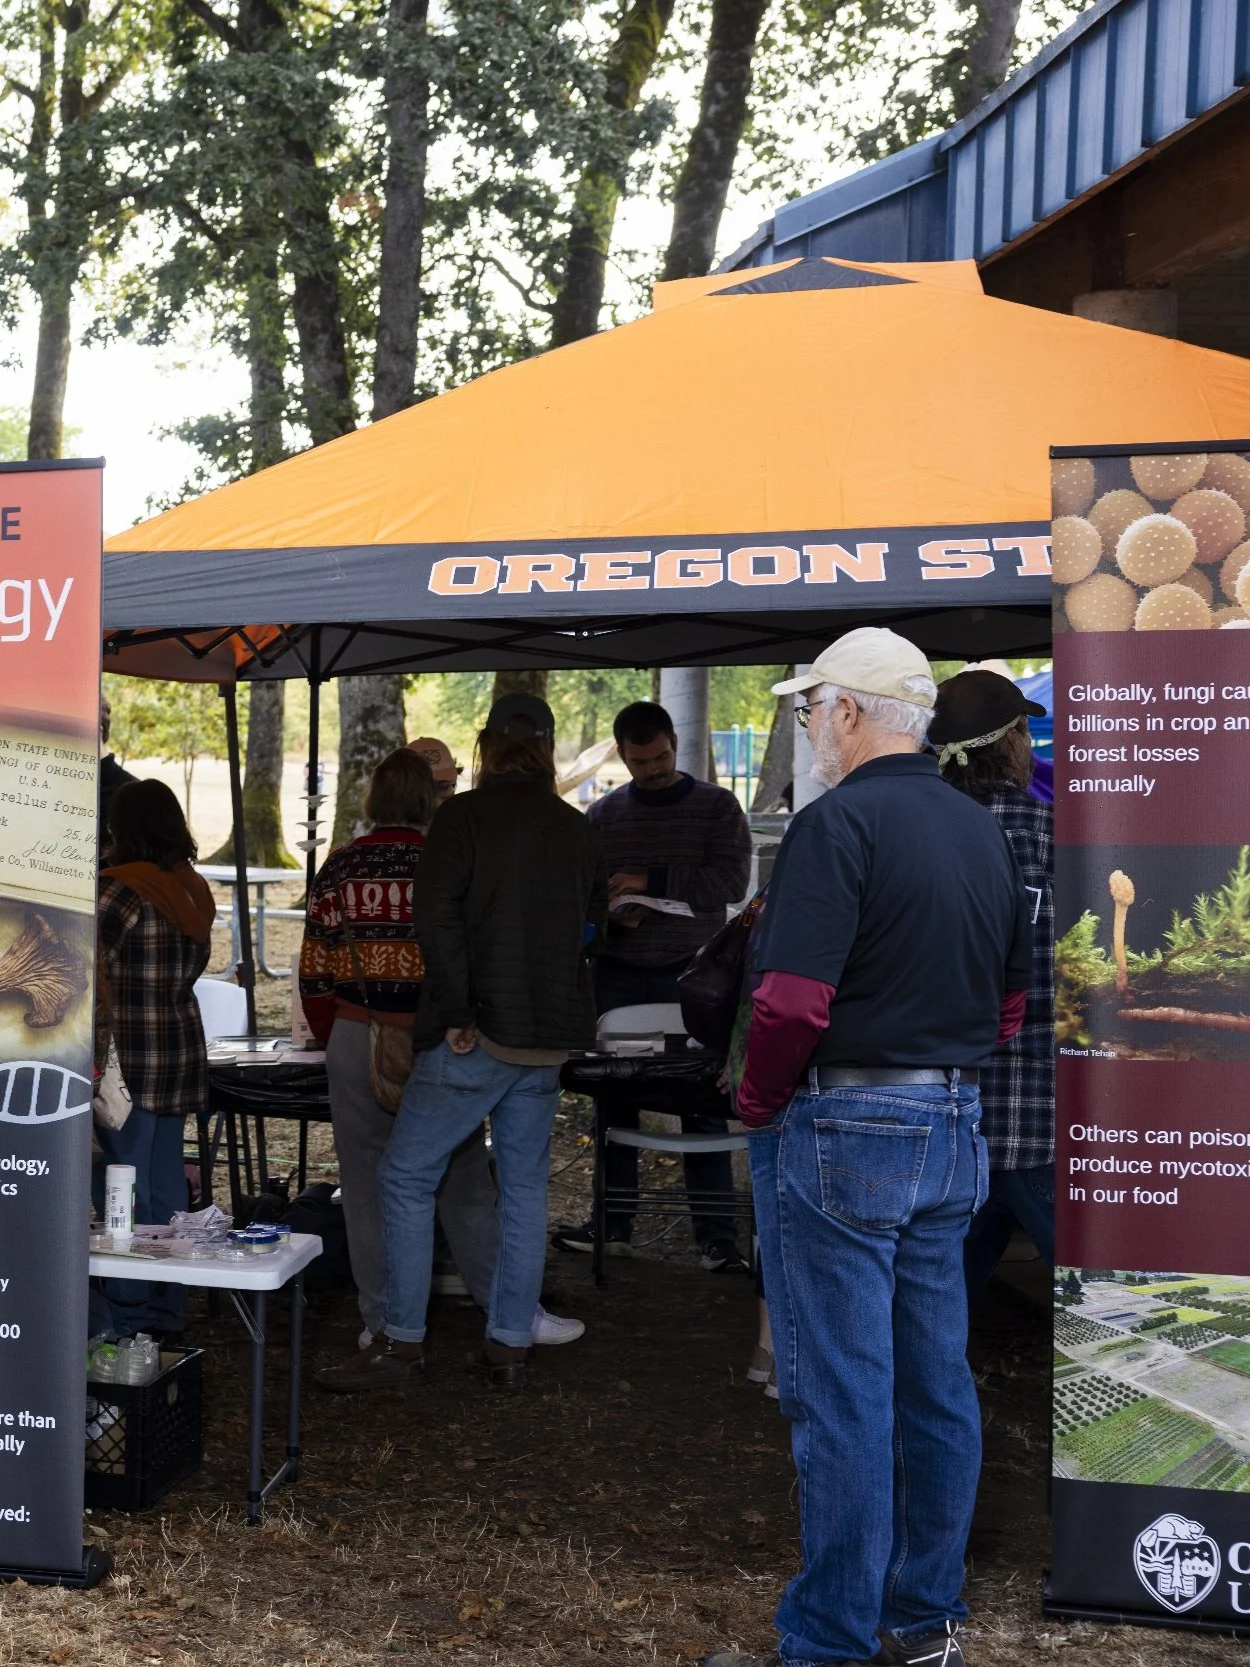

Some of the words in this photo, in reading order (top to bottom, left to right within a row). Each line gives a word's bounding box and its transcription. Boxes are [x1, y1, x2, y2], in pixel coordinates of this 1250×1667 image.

[428, 542, 889, 596] OREGON
[917, 535, 1052, 580] ST
[1068, 683, 1157, 705] Globally,
[1163, 682, 1215, 705] fungi
[1221, 685, 1250, 700] ca
[1068, 714, 1140, 732] billions
[1146, 713, 1164, 731] in
[1170, 716, 1217, 735] crop
[1223, 716, 1250, 731] an
[15, 742, 50, 756] STATE
[1068, 744, 1128, 762] forest
[1133, 744, 1201, 762] losses
[25, 761, 41, 771] OF
[45, 764, 95, 782] OREGON
[1068, 774, 1156, 797] annually
[29, 858, 85, 879] Willamette
[1060, 1047, 1089, 1057] Richard
[1091, 1049, 1116, 1058] Tehan
[1069, 1124, 1139, 1144] Others
[1144, 1129, 1182, 1145] can
[1069, 1155, 1152, 1175] produce
[1069, 1183, 1086, 1201] in
[1092, 1188, 1127, 1204] our
[1132, 1186, 1178, 1205] food
[17, 1411, 56, 1429] than
